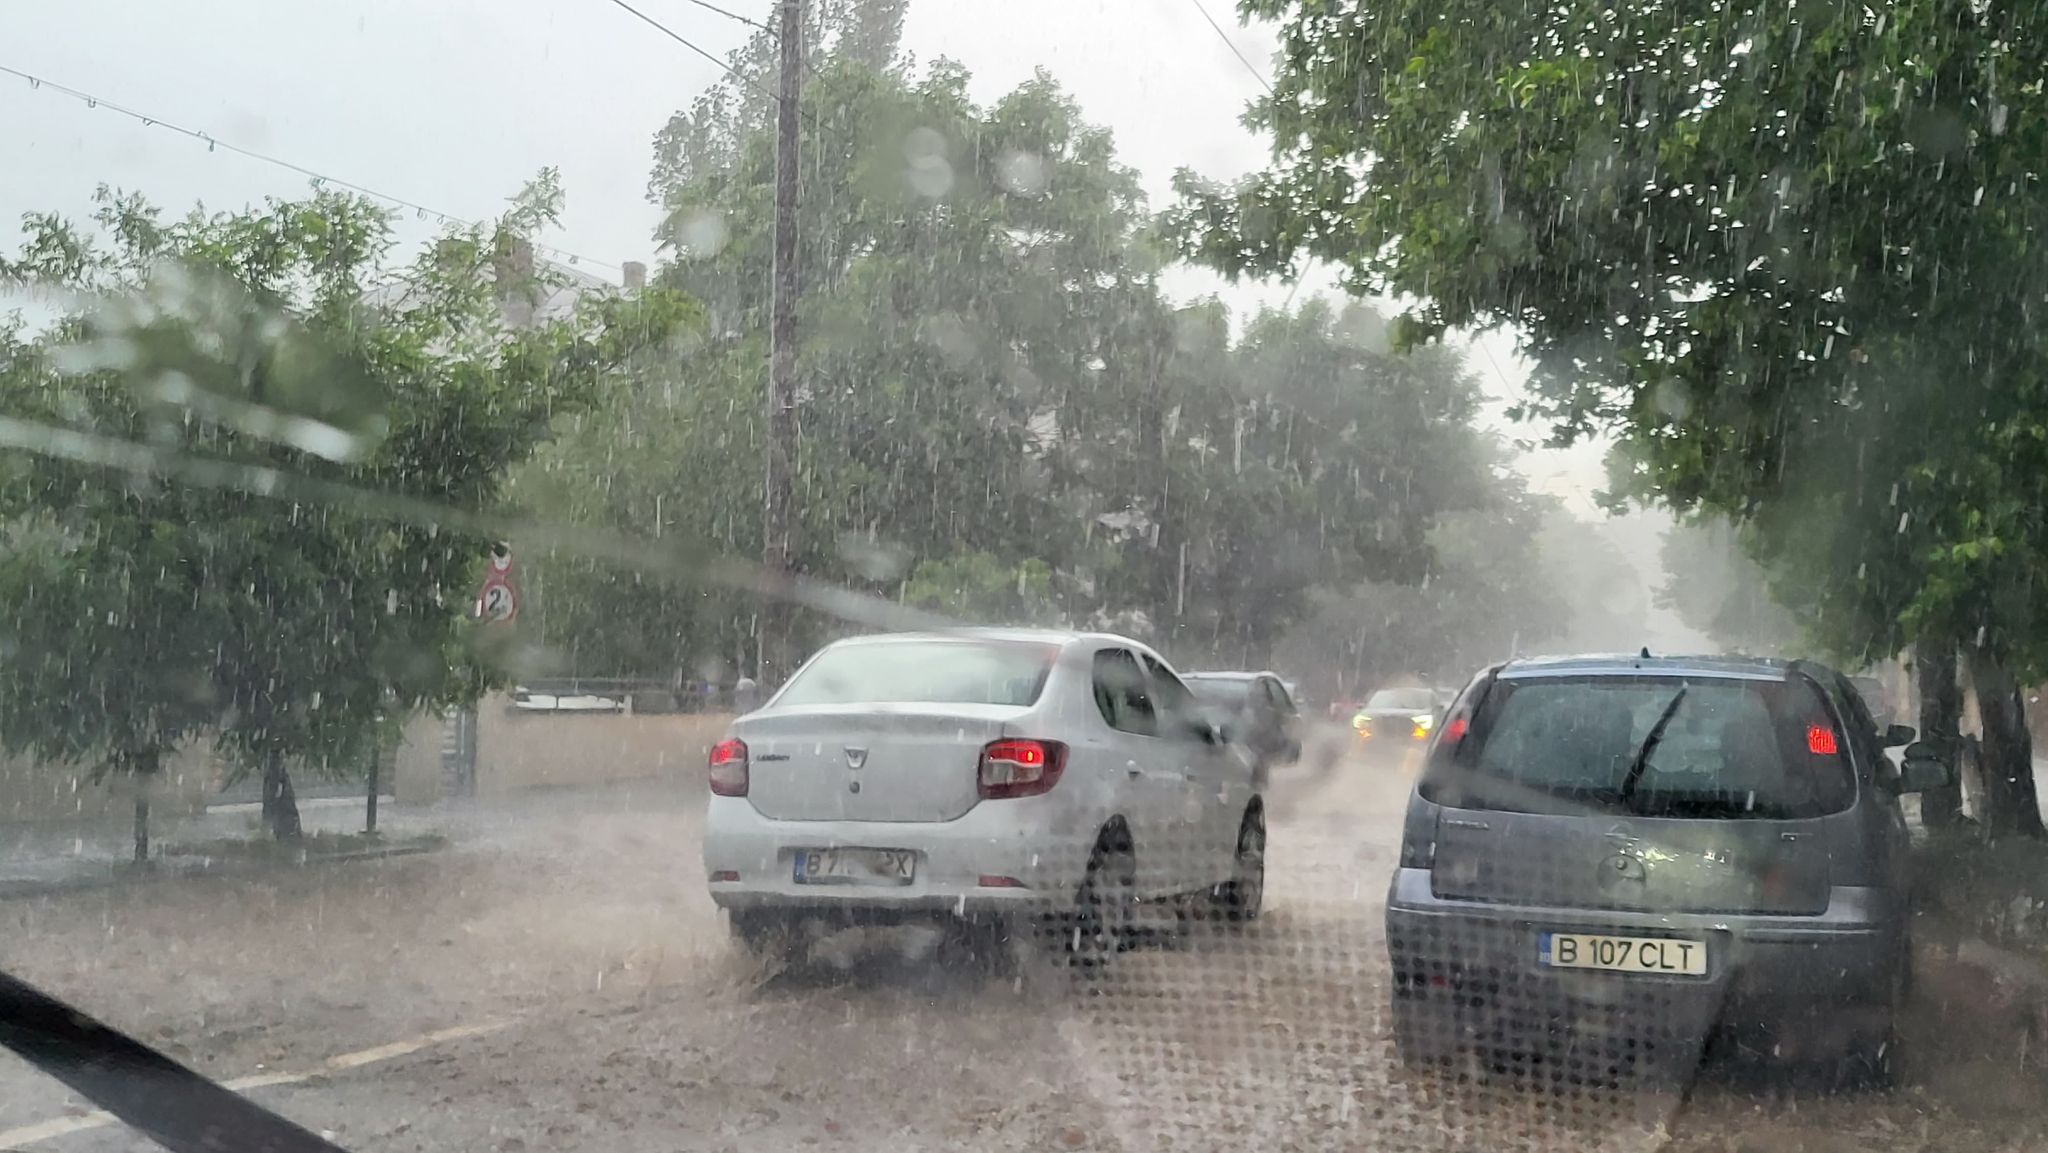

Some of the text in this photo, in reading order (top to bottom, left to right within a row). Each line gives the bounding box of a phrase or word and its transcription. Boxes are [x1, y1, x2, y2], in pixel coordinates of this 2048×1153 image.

[1559, 938, 1577, 963] B
[1590, 940, 1632, 966] 107
[1639, 943, 1693, 970] CLT
